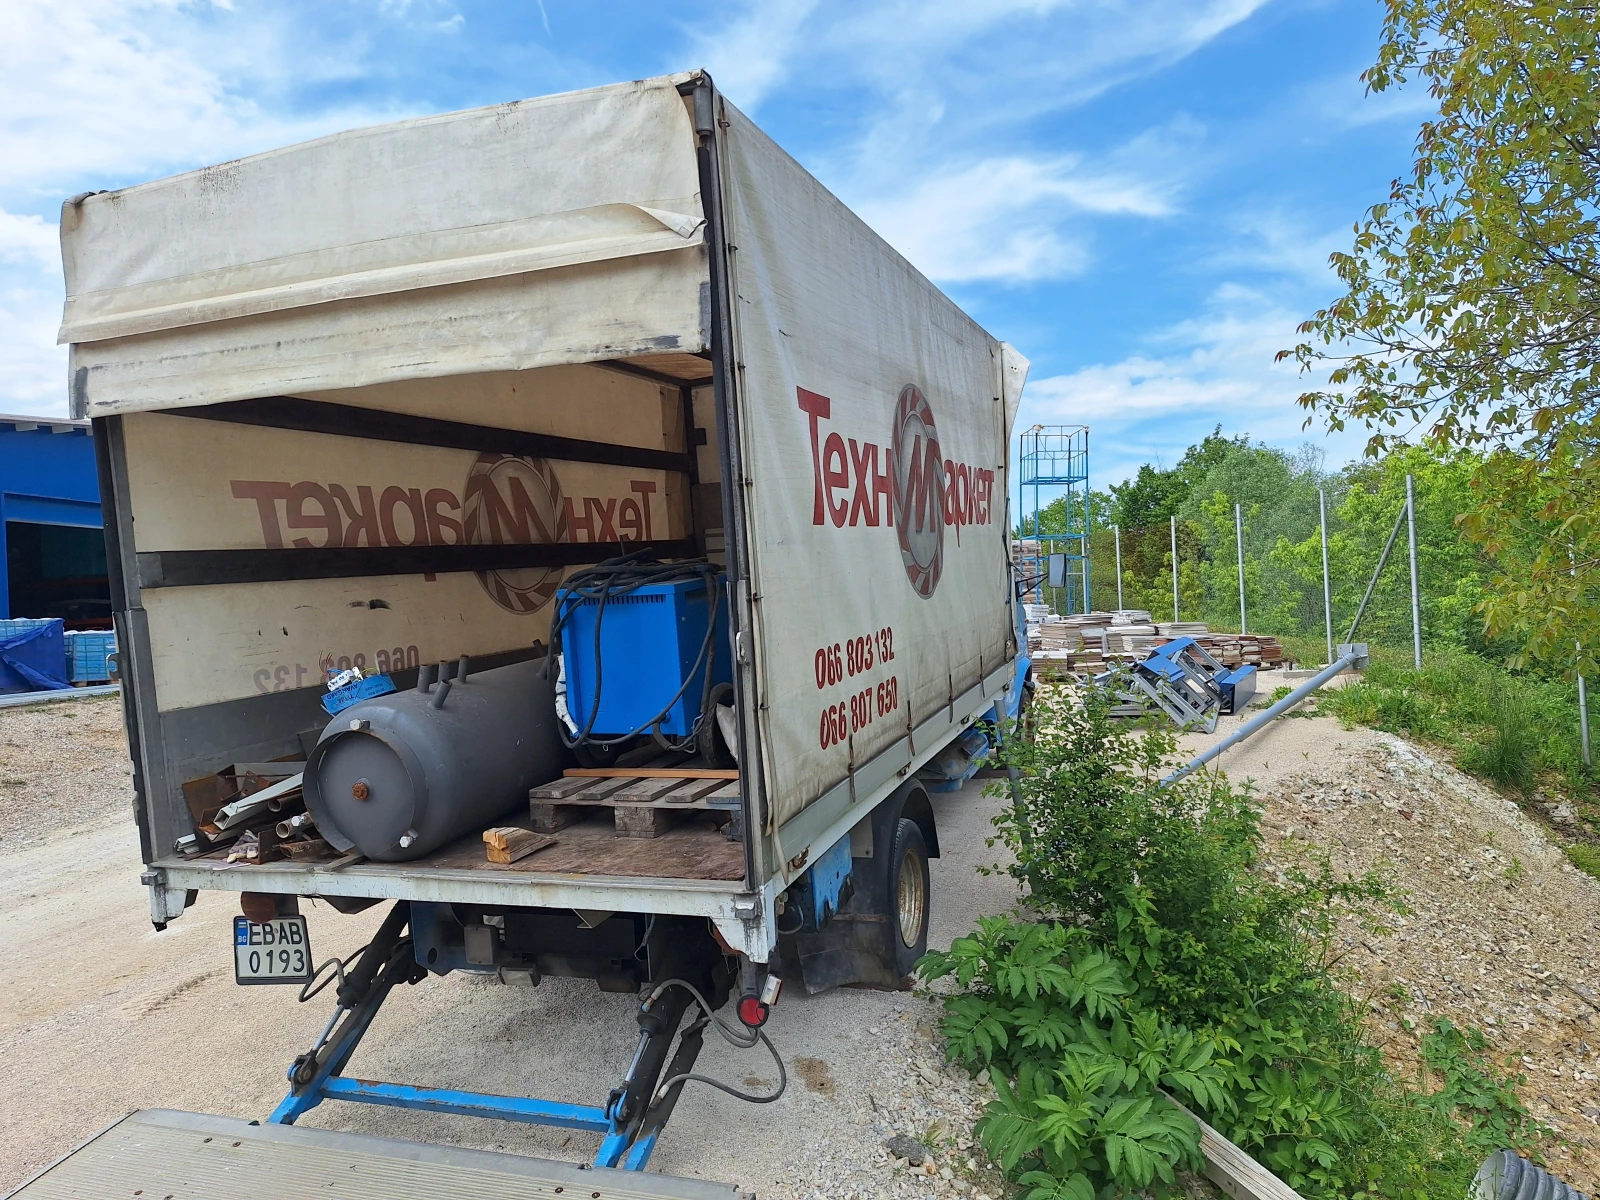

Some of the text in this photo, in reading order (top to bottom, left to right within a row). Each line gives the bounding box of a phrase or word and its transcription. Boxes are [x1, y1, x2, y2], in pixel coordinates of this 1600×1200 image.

[815, 626, 895, 689] 066 803 132
[820, 676, 898, 750] 066 807 650
[238, 935, 247, 943] BG
[249, 949, 305, 974] 0193
